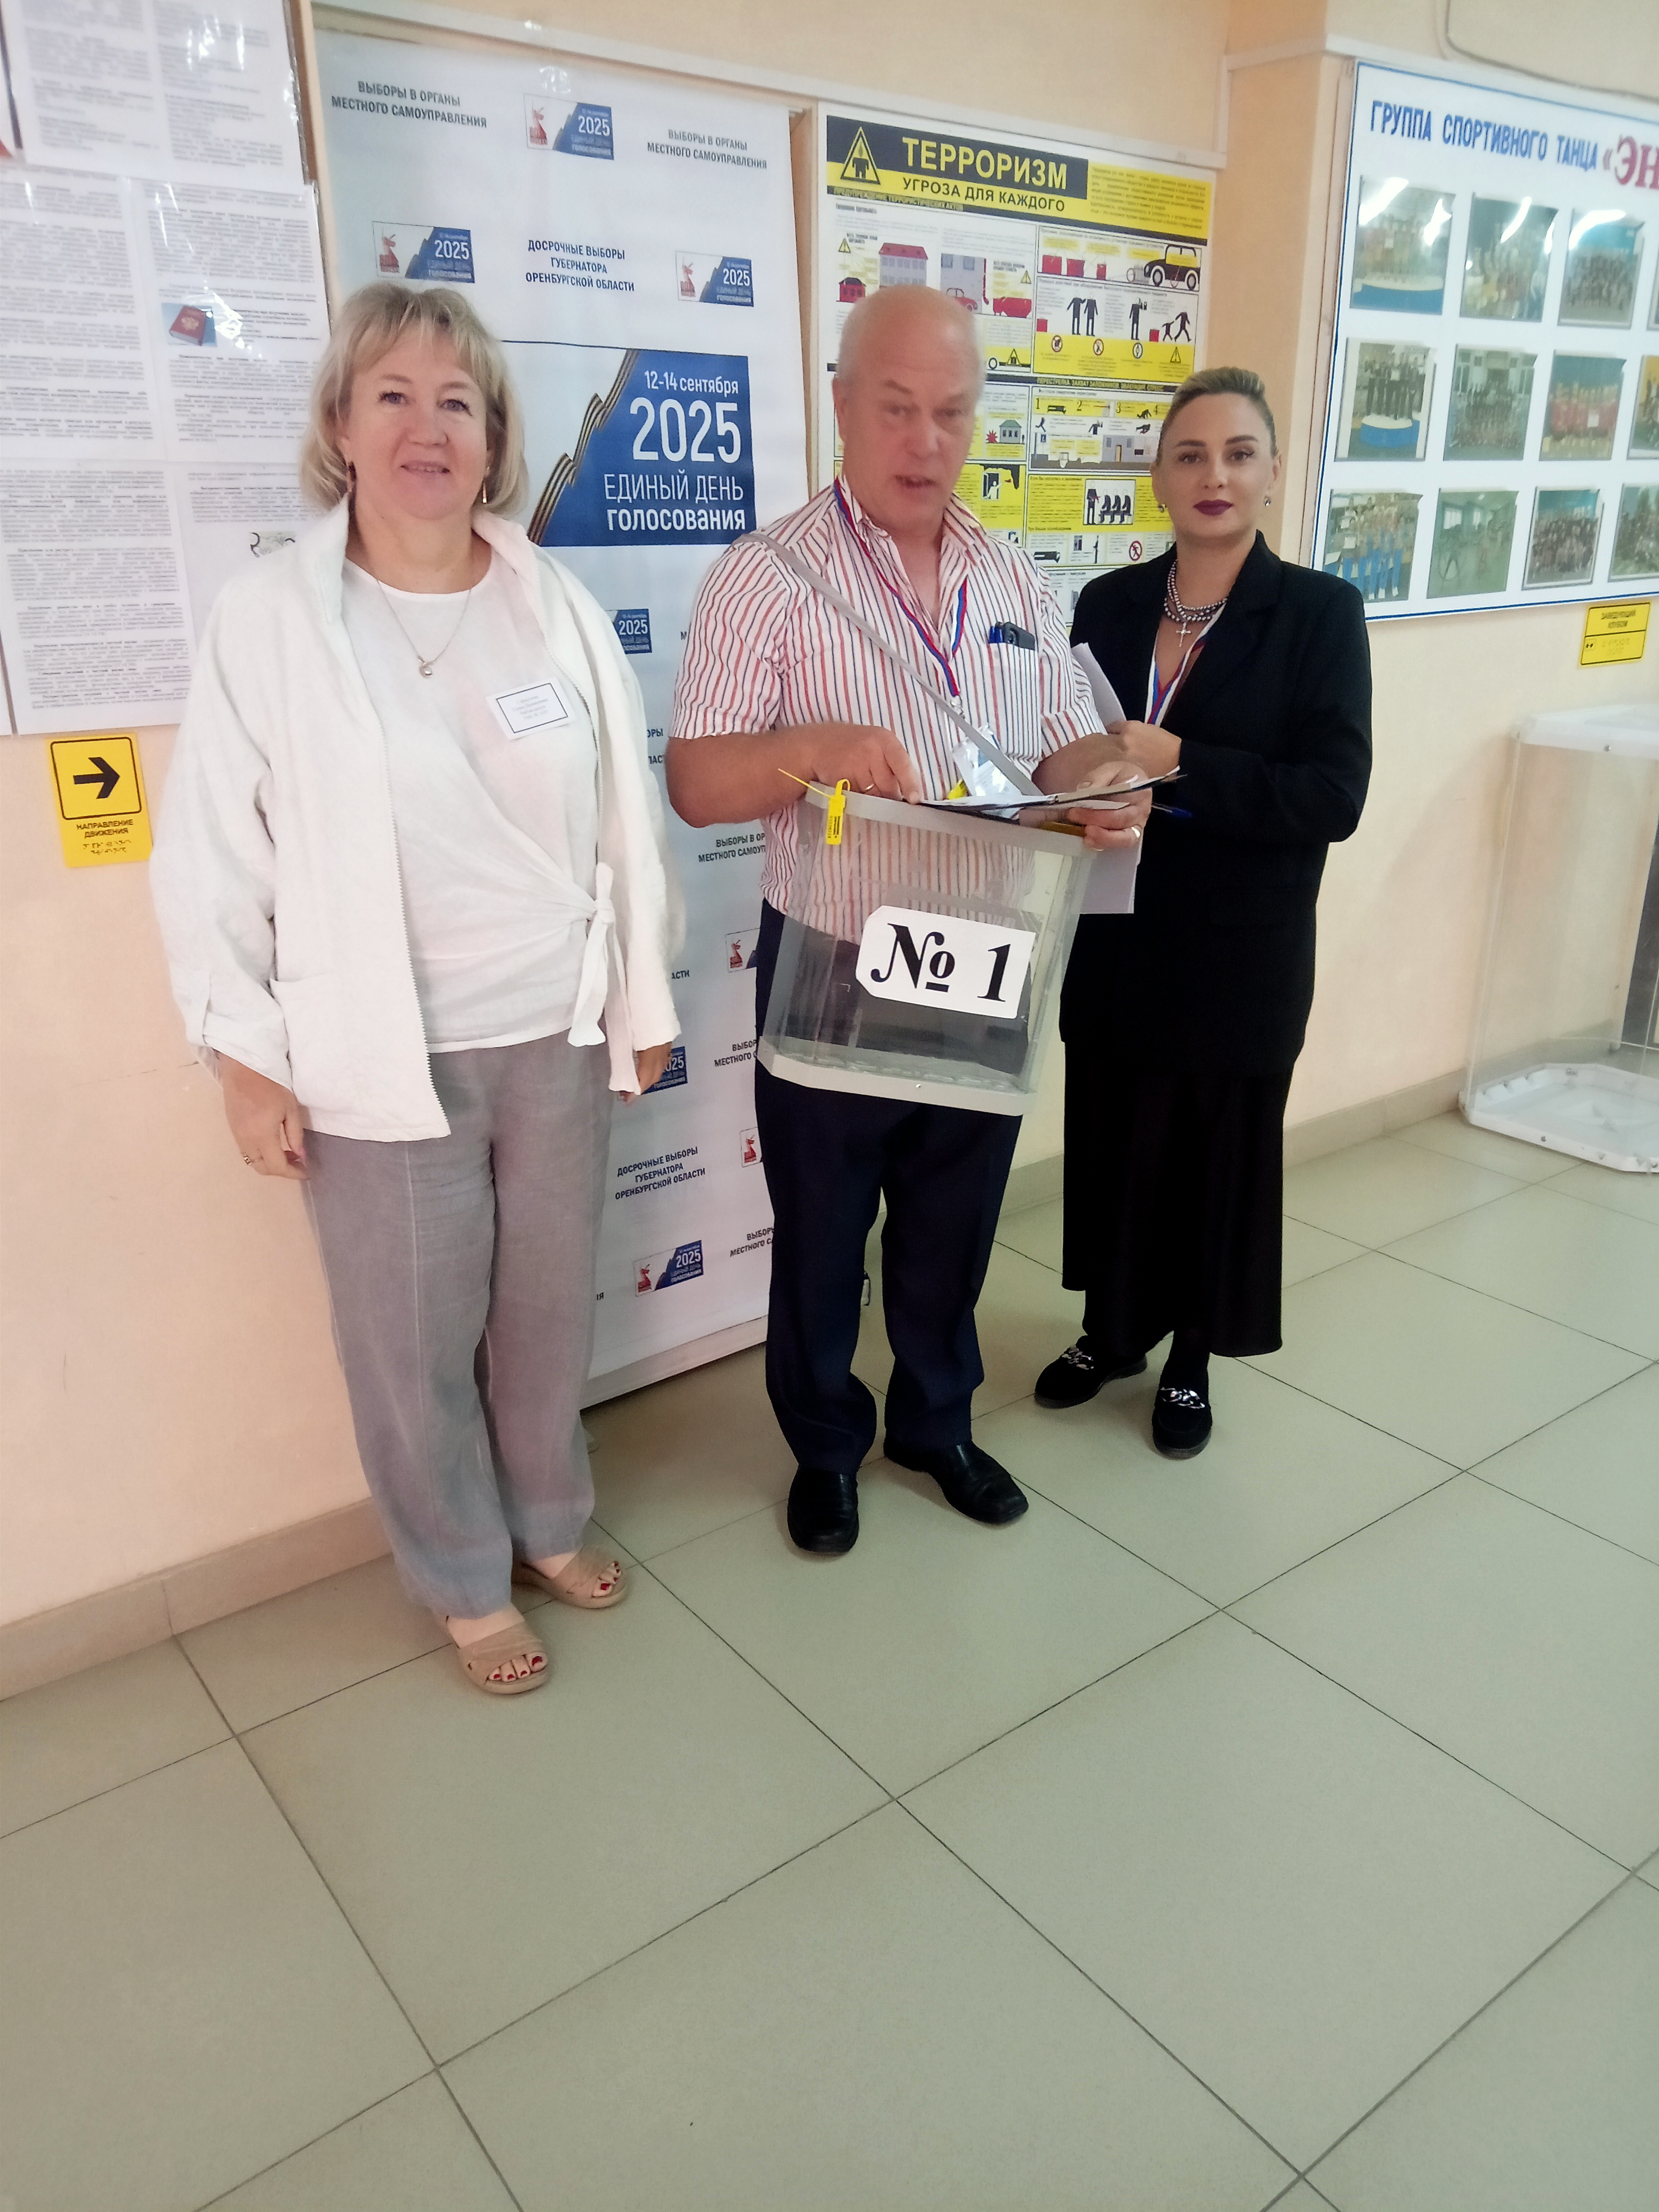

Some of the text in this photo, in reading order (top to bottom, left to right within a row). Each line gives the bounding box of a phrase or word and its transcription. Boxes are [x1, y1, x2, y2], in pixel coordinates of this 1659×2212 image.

[358, 80, 460, 107] ВЫБОРЫ В ОРГАНЫ
[331, 96, 487, 128] МЕСТНОГО САМОУПРАВЛЕНИЯ
[578, 115, 610, 136] 2025
[668, 129, 747, 150] ВЫБОРЫ В ОРГАНЫ
[1370, 100, 1431, 141] ГРУППА
[1443, 113, 1548, 161] СПОРТИВНОГО
[1556, 135, 1598, 172] ТАНЦА
[647, 142, 767, 169] МЕСТНОГО САМОУПРАВЛЕНИЯ
[902, 137, 1067, 190] ТЕРРОРИЗМ
[903, 177, 960, 197] УГРОЗА
[965, 186, 994, 202] ДЛЯ
[999, 191, 1065, 212] КАЖДОГО
[434, 240, 470, 260] 2025
[528, 239, 625, 259] ДОСРОЧНЫЕ ВЫБОРЫ
[551, 257, 608, 274] ГУБЕРНАТОРА
[525, 272, 635, 291] ОРЕНБУРГСКОЙ ОБЛАСТИ
[723, 268, 750, 287] 2025
[644, 370, 739, 397] 12-14 сентября
[1036, 398, 1040, 409] 1
[1077, 400, 1082, 411] 2
[1117, 400, 1121, 413] 3
[630, 397, 741, 463] 2025
[604, 469, 743, 504] ЕДИНЫЙ ДЕНЬ
[618, 619, 648, 635] 2025
[76, 819, 133, 831] НАПРАВЛЕНИЕ
[85, 827, 129, 839] ДВИЖЕНИЯ
[716, 835, 748, 848] ВЫБОРЫ
[698, 850, 736, 862] МЕСТНОГО
[977, 943, 1011, 1002] 1
[732, 1039, 757, 1052] ВЫБОР
[664, 1055, 684, 1072] 025
[714, 1052, 751, 1067] МЕСТНОГО
[617, 1146, 698, 1177] ДОСРОЧНЫЕ ВЫБОРЫ
[635, 1162, 684, 1183] ГУБЕРНАТОРА
[615, 1168, 706, 1200] ОРЕНБУРГСКОЙ ОБЛАСТИ
[676, 1249, 701, 1268] 2025
[730, 1240, 765, 1257] МЕСТНОГО
